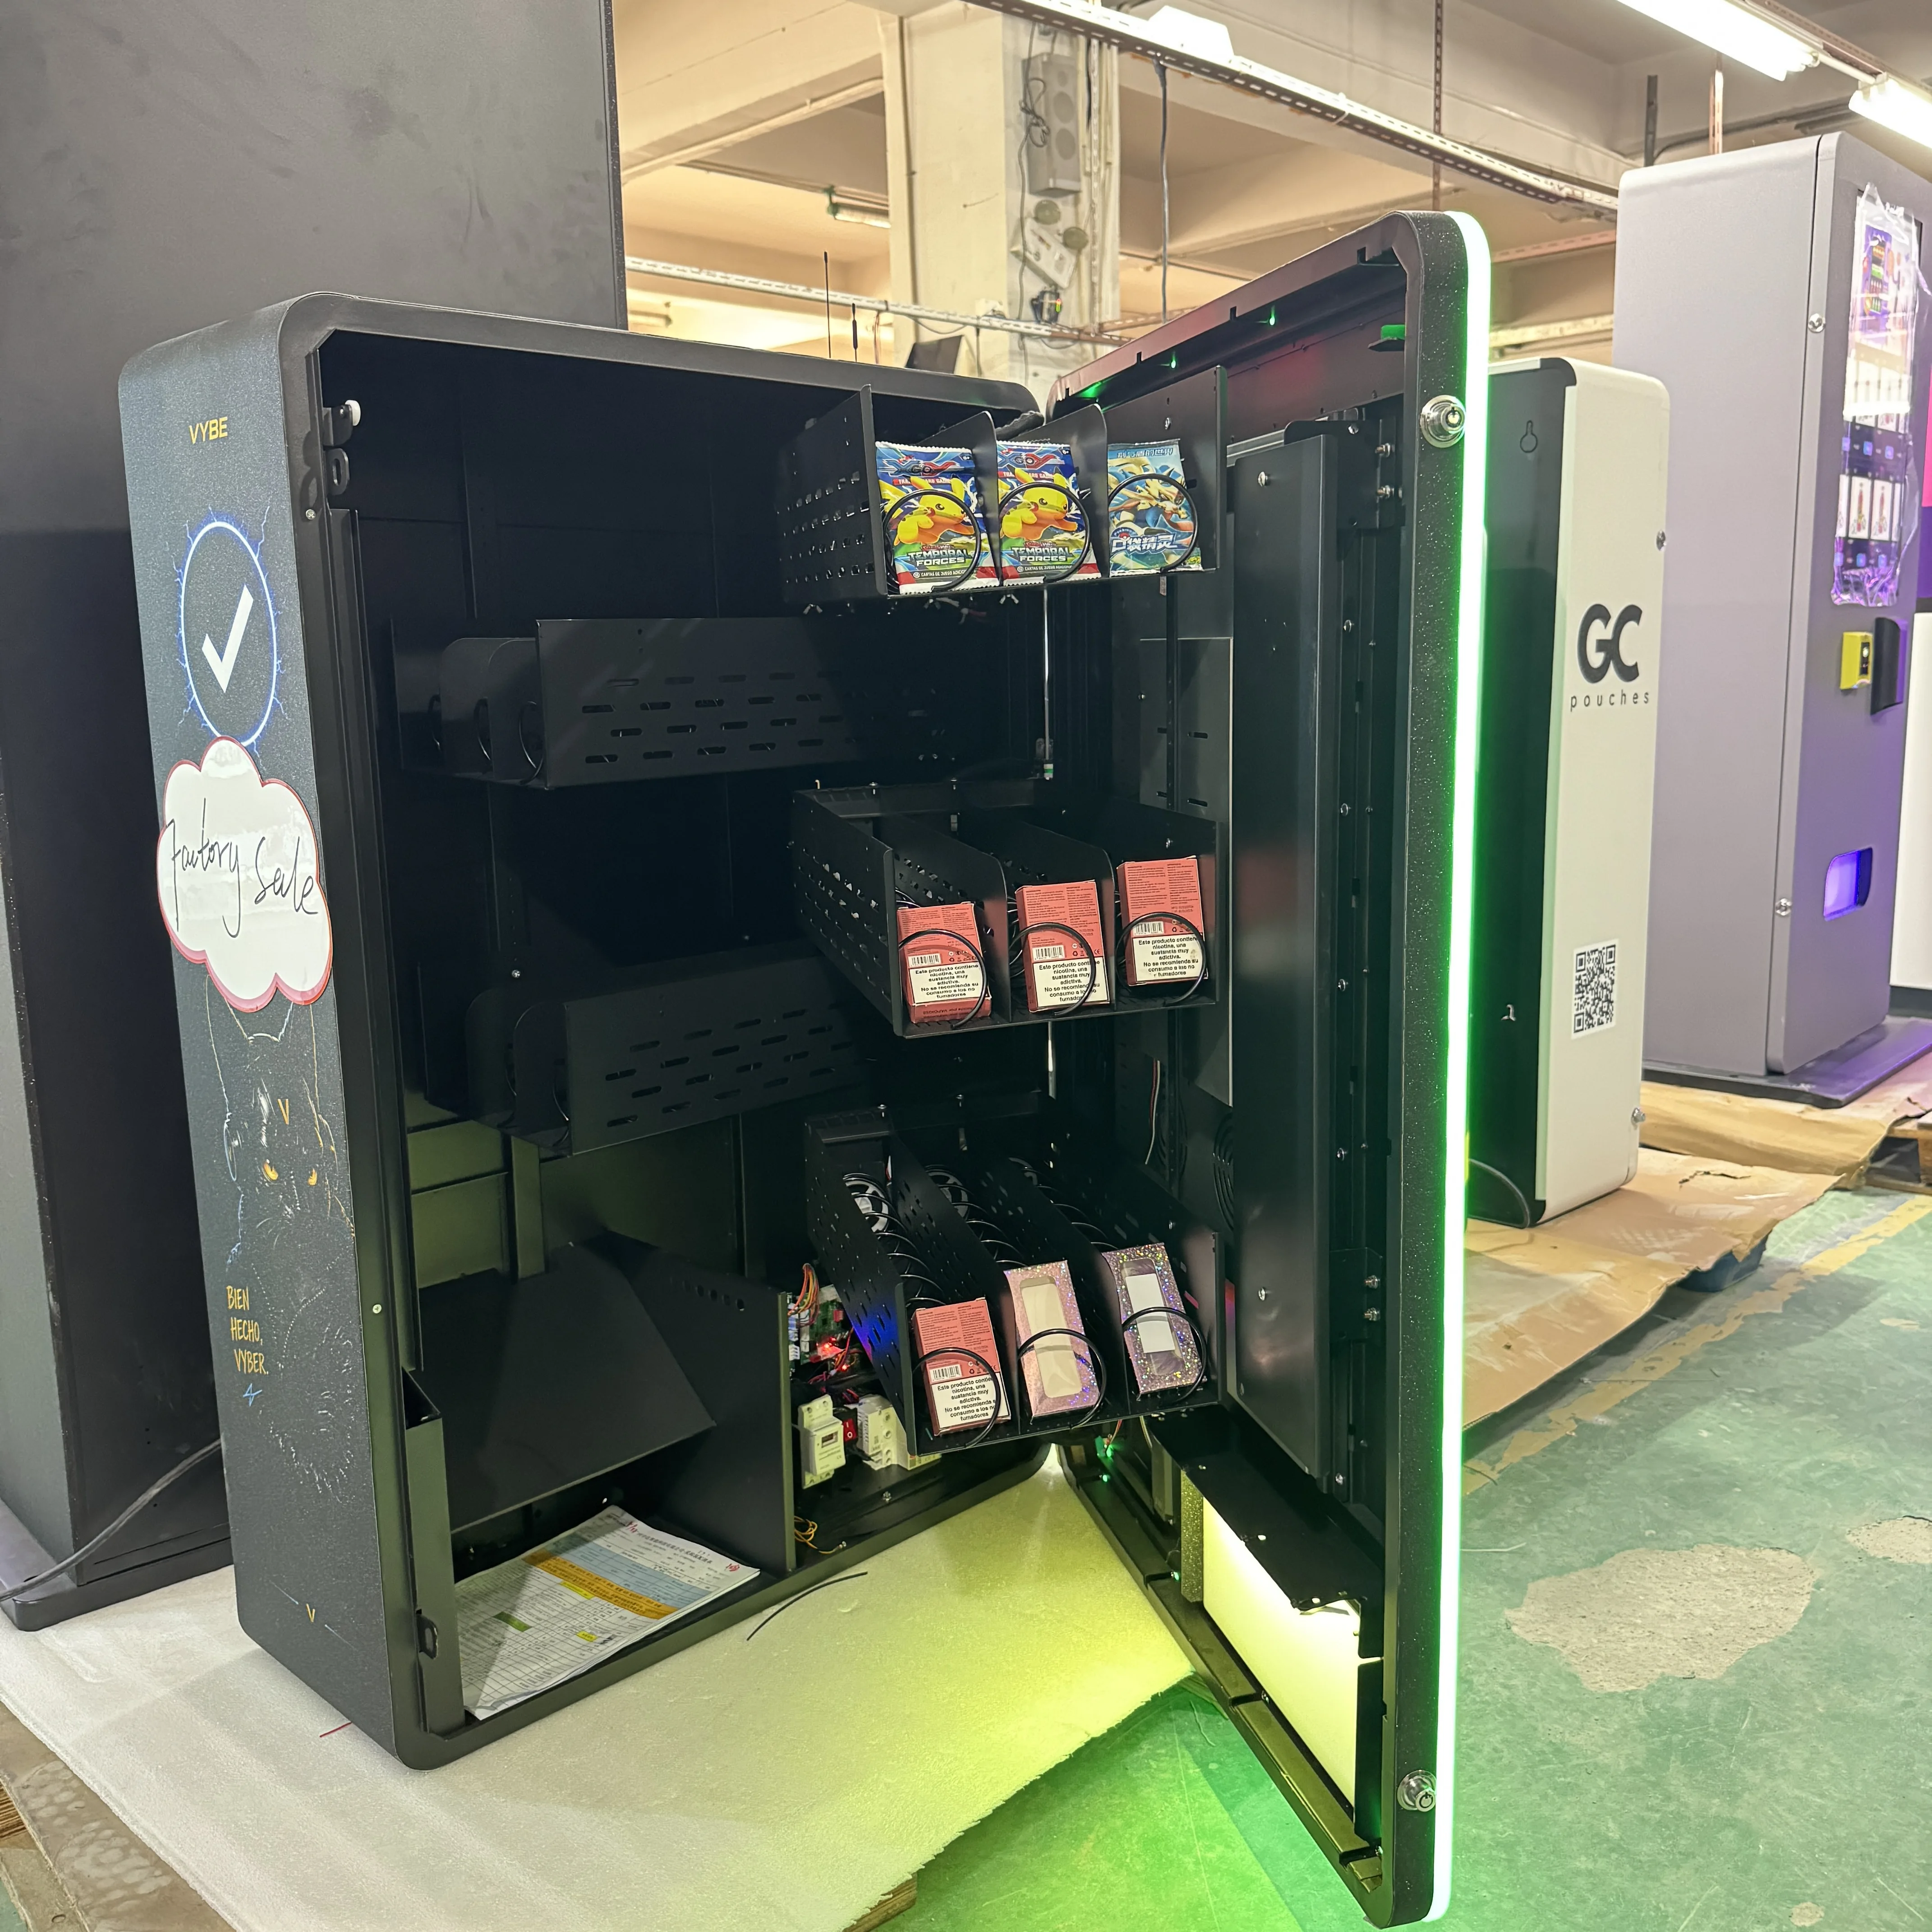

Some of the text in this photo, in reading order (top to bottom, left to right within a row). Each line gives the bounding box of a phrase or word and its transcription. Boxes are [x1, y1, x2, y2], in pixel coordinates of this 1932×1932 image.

[189, 416, 228, 444] VYBE
[1012, 547, 1072, 557] TEMPORAL
[1111, 534, 1178, 552] 口袋精灵
[908, 549, 971, 561] TEMPORAL
[916, 557, 965, 566] FORCES
[1577, 604, 1642, 683] GC
[1571, 690, 1649, 712] pouches
[226, 1285, 249, 1311] BIEN
[230, 1316, 262, 1345] HECHO,
[234, 1348, 268, 1375] VYBER.
[951, 1380, 974, 1389] producto
